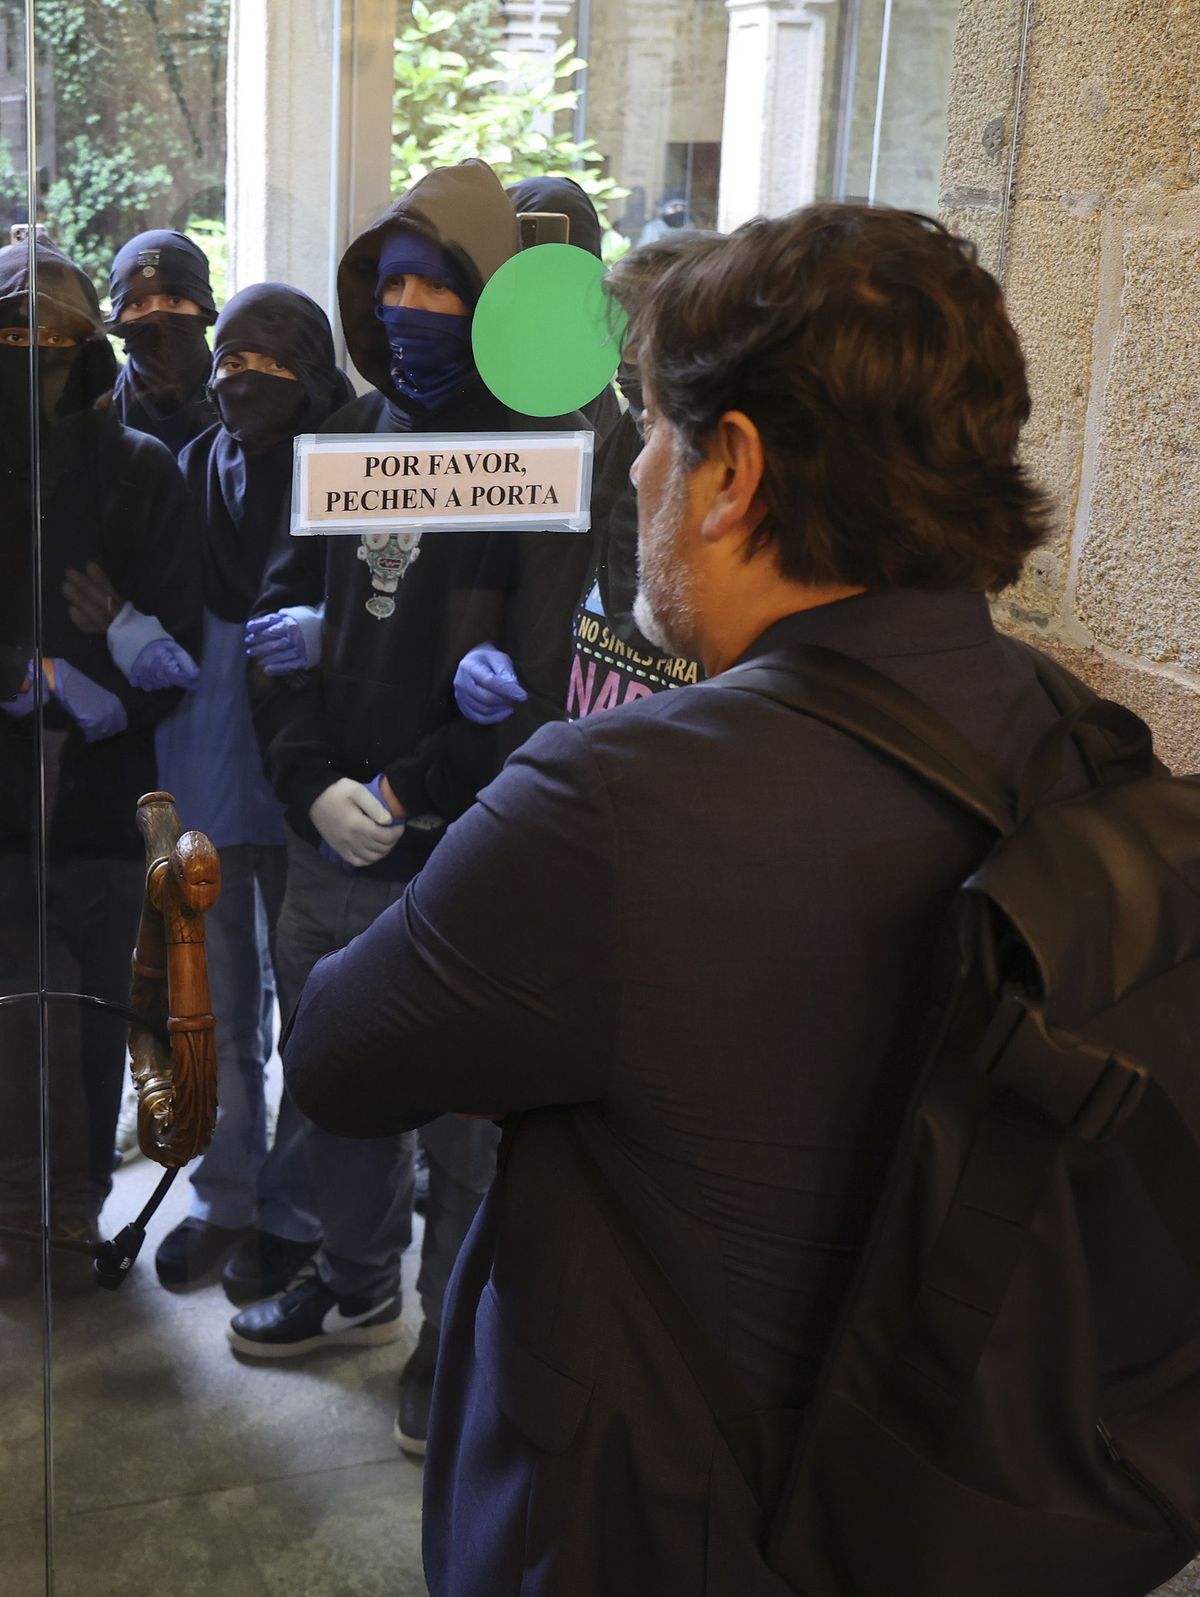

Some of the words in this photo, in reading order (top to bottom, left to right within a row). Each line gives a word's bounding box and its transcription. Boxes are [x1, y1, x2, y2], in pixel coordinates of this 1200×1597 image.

[363, 455, 421, 477] POR
[427, 452, 527, 477] FAVOR,
[325, 487, 438, 512] PECHEN
[444, 488, 462, 508] A
[470, 484, 559, 507] PORTA
[578, 615, 599, 643] NO
